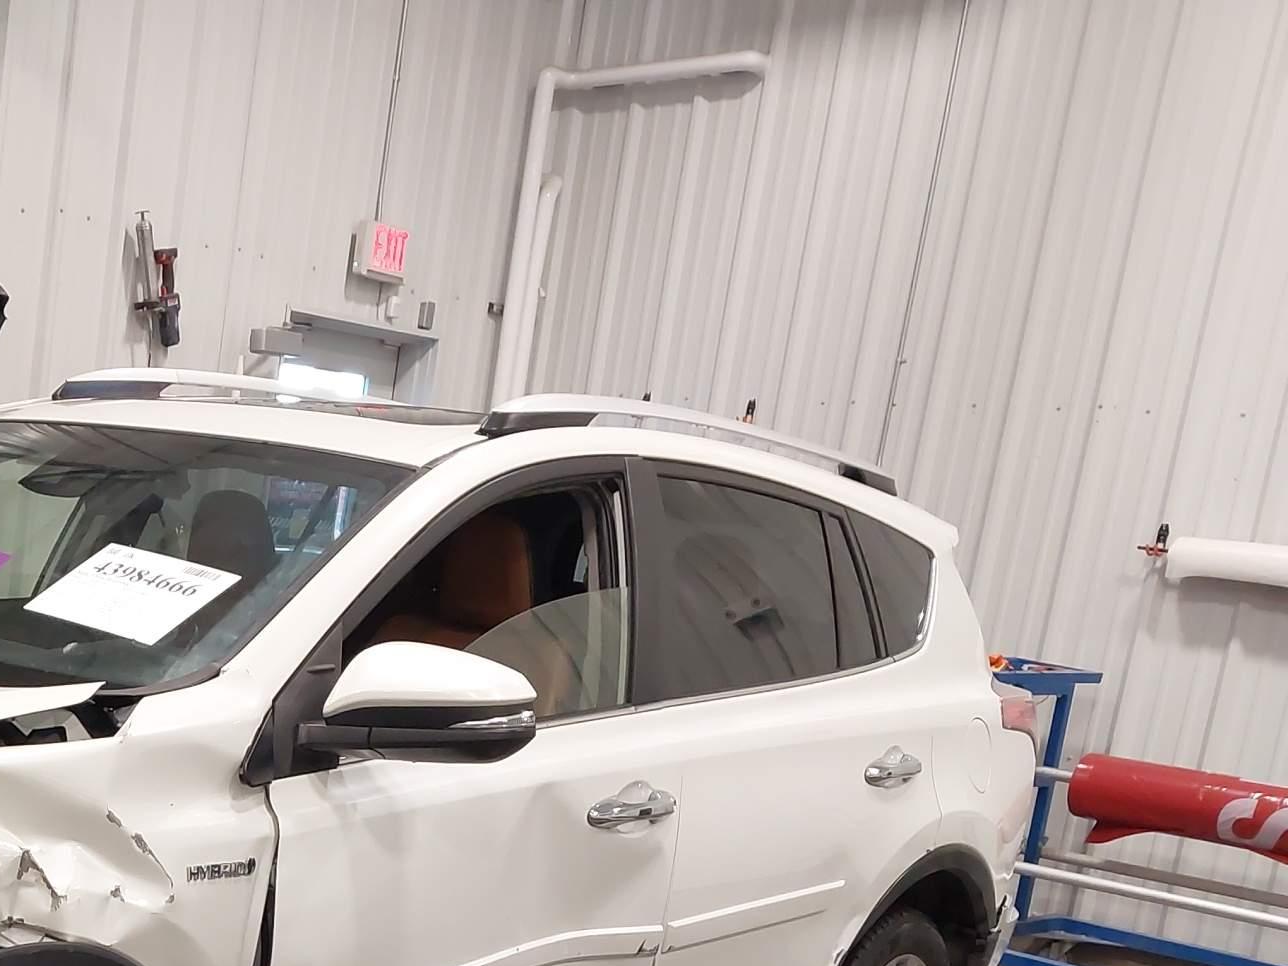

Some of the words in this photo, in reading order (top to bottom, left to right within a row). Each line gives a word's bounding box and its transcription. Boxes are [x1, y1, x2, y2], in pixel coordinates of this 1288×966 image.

[375, 225, 409, 272] EXIT
[94, 561, 200, 597] 43984666
[186, 861, 247, 882] HYBRID
